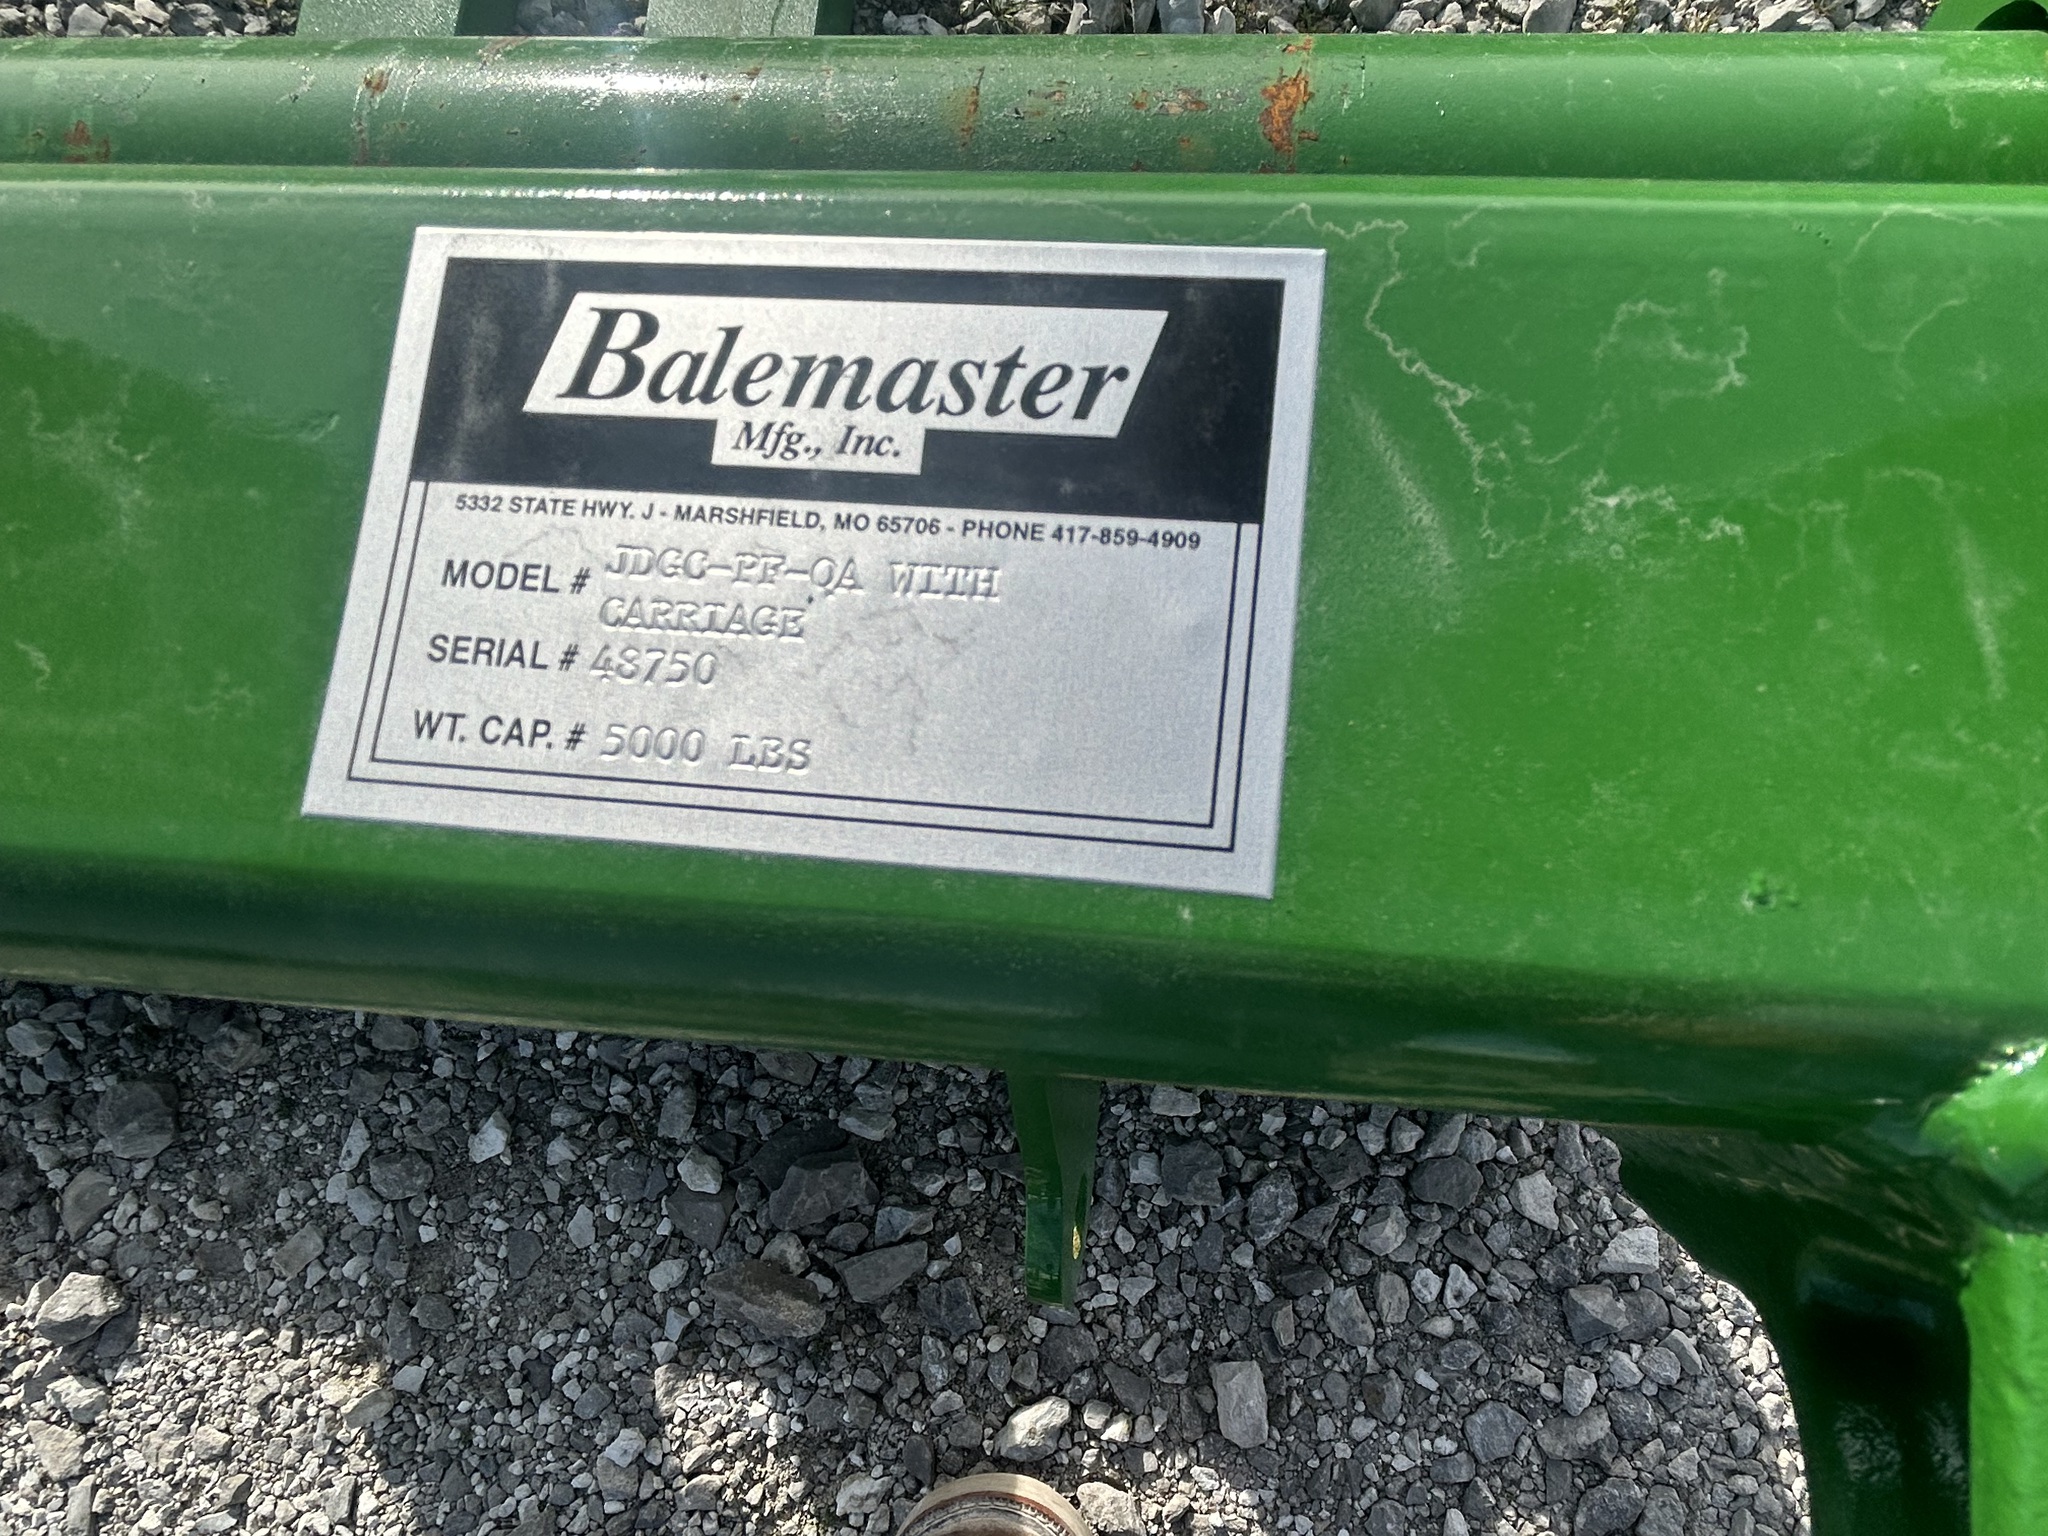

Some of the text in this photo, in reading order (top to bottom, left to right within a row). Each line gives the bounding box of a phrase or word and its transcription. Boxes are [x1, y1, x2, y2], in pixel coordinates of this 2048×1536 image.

[558, 307, 1131, 421] Balemaster
[730, 421, 902, 463] Mfg., Inc.
[455, 493, 503, 513] 5332
[508, 497, 576, 519] STATE
[581, 501, 636, 522] HWY.
[641, 505, 654, 523] J
[674, 505, 828, 533] MARSHFIELD,
[834, 513, 870, 533] MO
[876, 515, 941, 537] 65706
[962, 523, 1046, 543] PHONE
[1051, 526, 1202, 551] 417-859-4909
[441, 558, 560, 595] MODEL
[570, 568, 591, 594] #
[889, 561, 1002, 604] WITH
[599, 596, 806, 645] CARRIAGE
[427, 634, 720, 688] SERIAL # 48750
[414, 709, 812, 777] WT. CAP. # 5000 LBS
